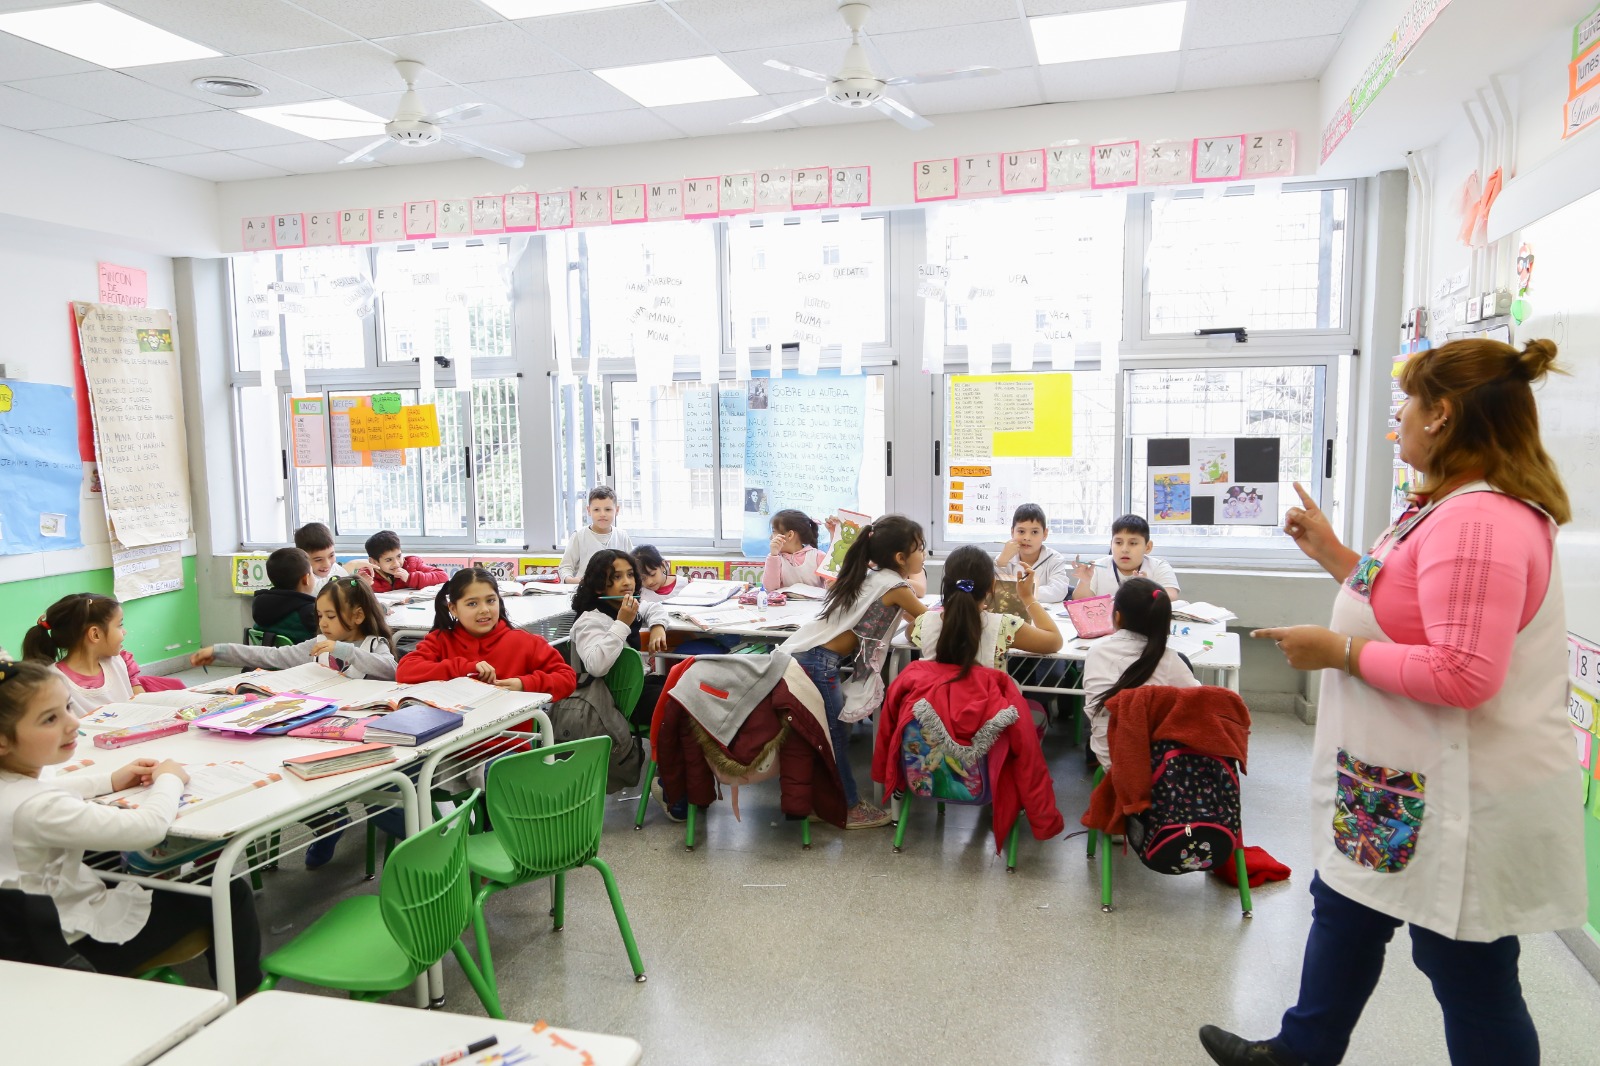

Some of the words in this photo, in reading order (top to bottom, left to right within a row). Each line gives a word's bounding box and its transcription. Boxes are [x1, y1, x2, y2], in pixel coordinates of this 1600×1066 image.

[1579, 15, 1600, 45] LUNE
[1204, 140, 1214, 154] Y
[1226, 143, 1233, 155] y
[1254, 136, 1262, 150] Z
[1277, 138, 1283, 148] z
[1053, 149, 1063, 162] V
[1075, 151, 1082, 161] v
[1098, 148, 1112, 160] W
[1120, 149, 1131, 158] w
[1152, 147, 1161, 159] X
[1173, 148, 1180, 158] x
[965, 158, 975, 170] T
[986, 159, 991, 168] t
[1009, 155, 1018, 167] U
[1030, 155, 1037, 165] u
[922, 164, 931, 176] S
[942, 165, 948, 174] s
[724, 174, 732, 188] Ñ
[743, 177, 749, 187] ñ
[760, 173, 770, 184] O
[779, 175, 786, 183] o
[797, 171, 806, 183] P
[816, 173, 822, 182] p
[836, 170, 846, 182] Q
[855, 173, 862, 183] q
[652, 186, 661, 197] M
[668, 187, 677, 196] m
[688, 182, 697, 193] N
[706, 184, 712, 192] n
[580, 191, 588, 201] K
[597, 191, 602, 200] k
[616, 188, 624, 199] L
[477, 199, 485, 209] H
[493, 199, 499, 209] h
[511, 196, 515, 206] I
[544, 196, 550, 207] J
[410, 204, 417, 214] F
[426, 204, 430, 213] f
[442, 203, 451, 213] G
[344, 212, 352, 222] D
[359, 212, 365, 221] d
[378, 209, 385, 219] E
[392, 211, 398, 219] e
[247, 220, 255, 230] A
[278, 217, 286, 227] B
[292, 217, 298, 226] b
[311, 216, 318, 225] C
[326, 217, 331, 225] c
[101, 266, 131, 287] RINCÓN
[1007, 274, 1029, 285] UPA
[107, 282, 118, 293] DE
[101, 290, 147, 308] RECITADORES
[648, 312, 676, 324] MANO
[795, 311, 822, 328] PLUMA
[647, 329, 669, 342] MONA
[772, 384, 803, 398] SOBRE
[807, 388, 816, 397] LA
[819, 387, 849, 398] AUTORA
[300, 402, 317, 411] UNOS
[770, 401, 795, 413] HELEN
[799, 403, 831, 414] BEATRIX
[773, 418, 785, 426] EL
[797, 417, 806, 426] DE
[832, 418, 842, 427] DE
[103, 432, 110, 443] LA
[823, 442, 843, 450] OTRA
[846, 442, 857, 450] EN
[976, 504, 991, 512] CIEN
[253, 563, 263, 581] 0
[490, 567, 505, 578] 50
[1580, 655, 1588, 677] 8
[1570, 696, 1585, 724] RZO
